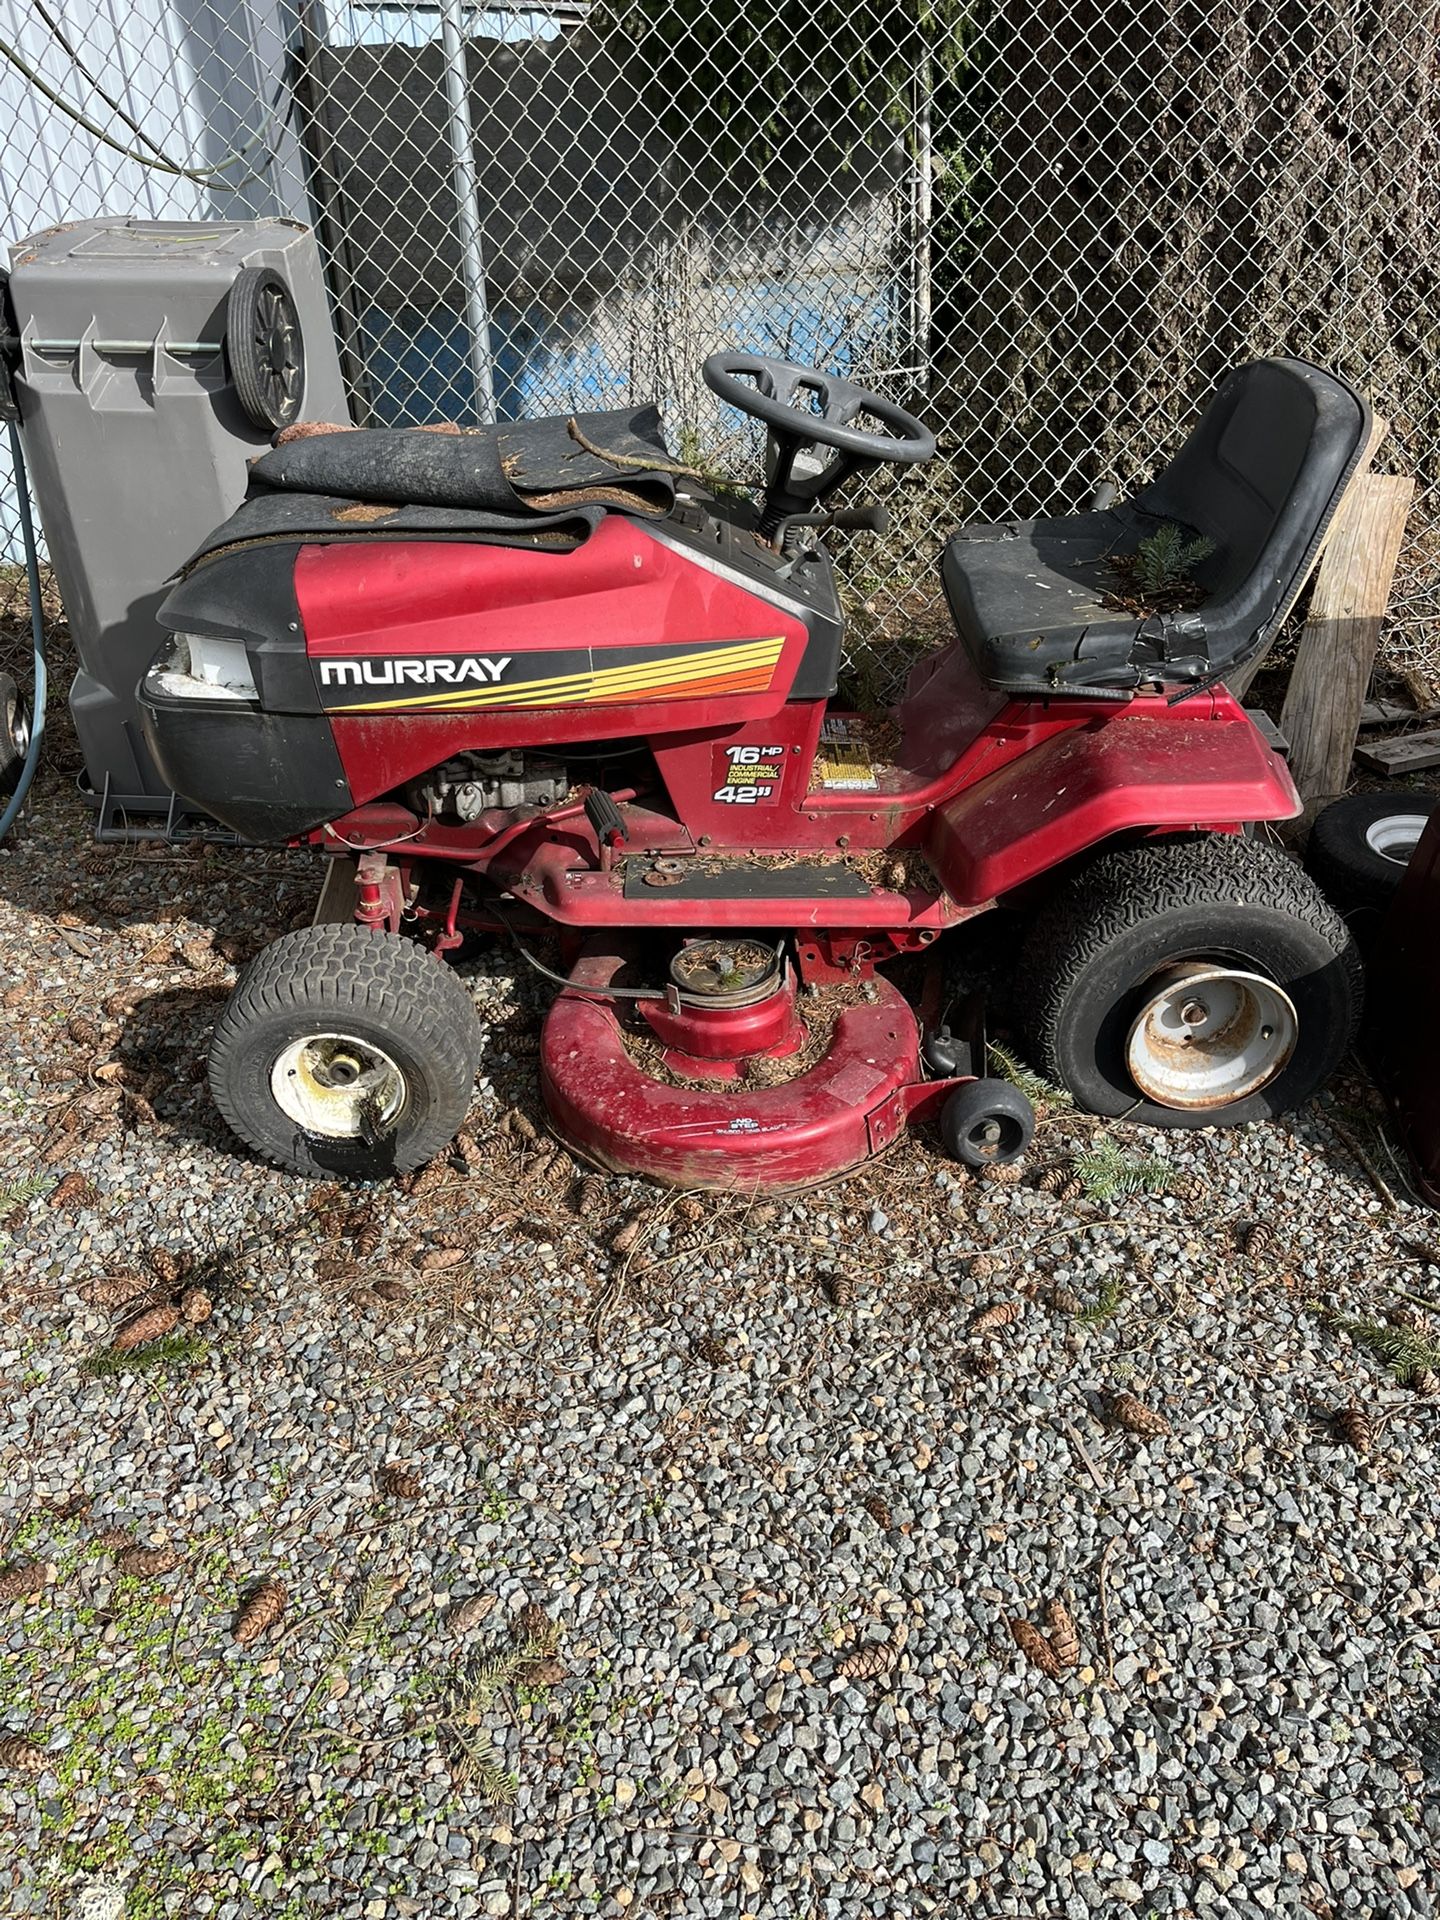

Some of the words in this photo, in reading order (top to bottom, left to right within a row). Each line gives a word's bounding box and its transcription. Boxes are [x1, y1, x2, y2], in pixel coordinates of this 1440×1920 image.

[319, 657, 512, 685] MURRAY
[726, 746, 760, 764] 16
[761, 746, 783, 755] HP
